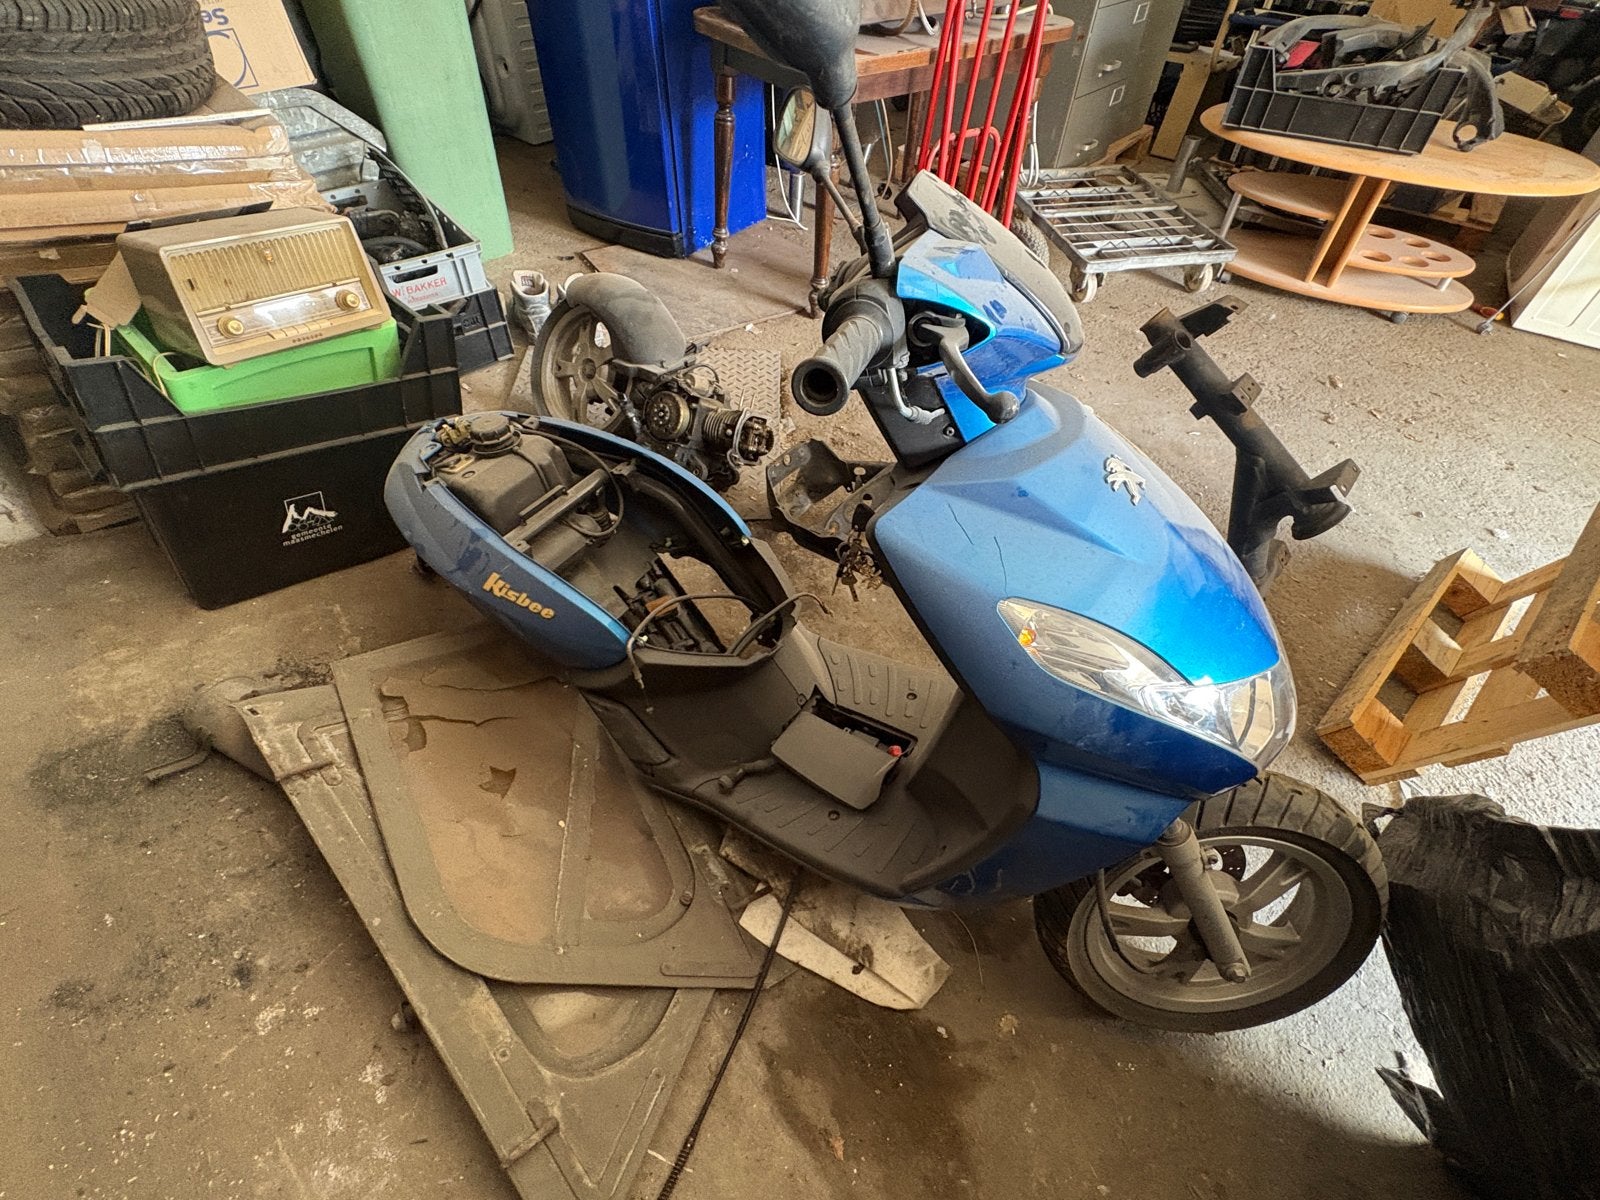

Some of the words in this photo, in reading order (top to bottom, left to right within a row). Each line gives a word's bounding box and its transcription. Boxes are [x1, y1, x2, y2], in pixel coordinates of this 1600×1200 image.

[406, 276, 447, 294] BAKKER
[282, 525, 343, 546] maasmechelen
[291, 524, 332, 539] gemeente
[482, 571, 555, 619] Kisbee
